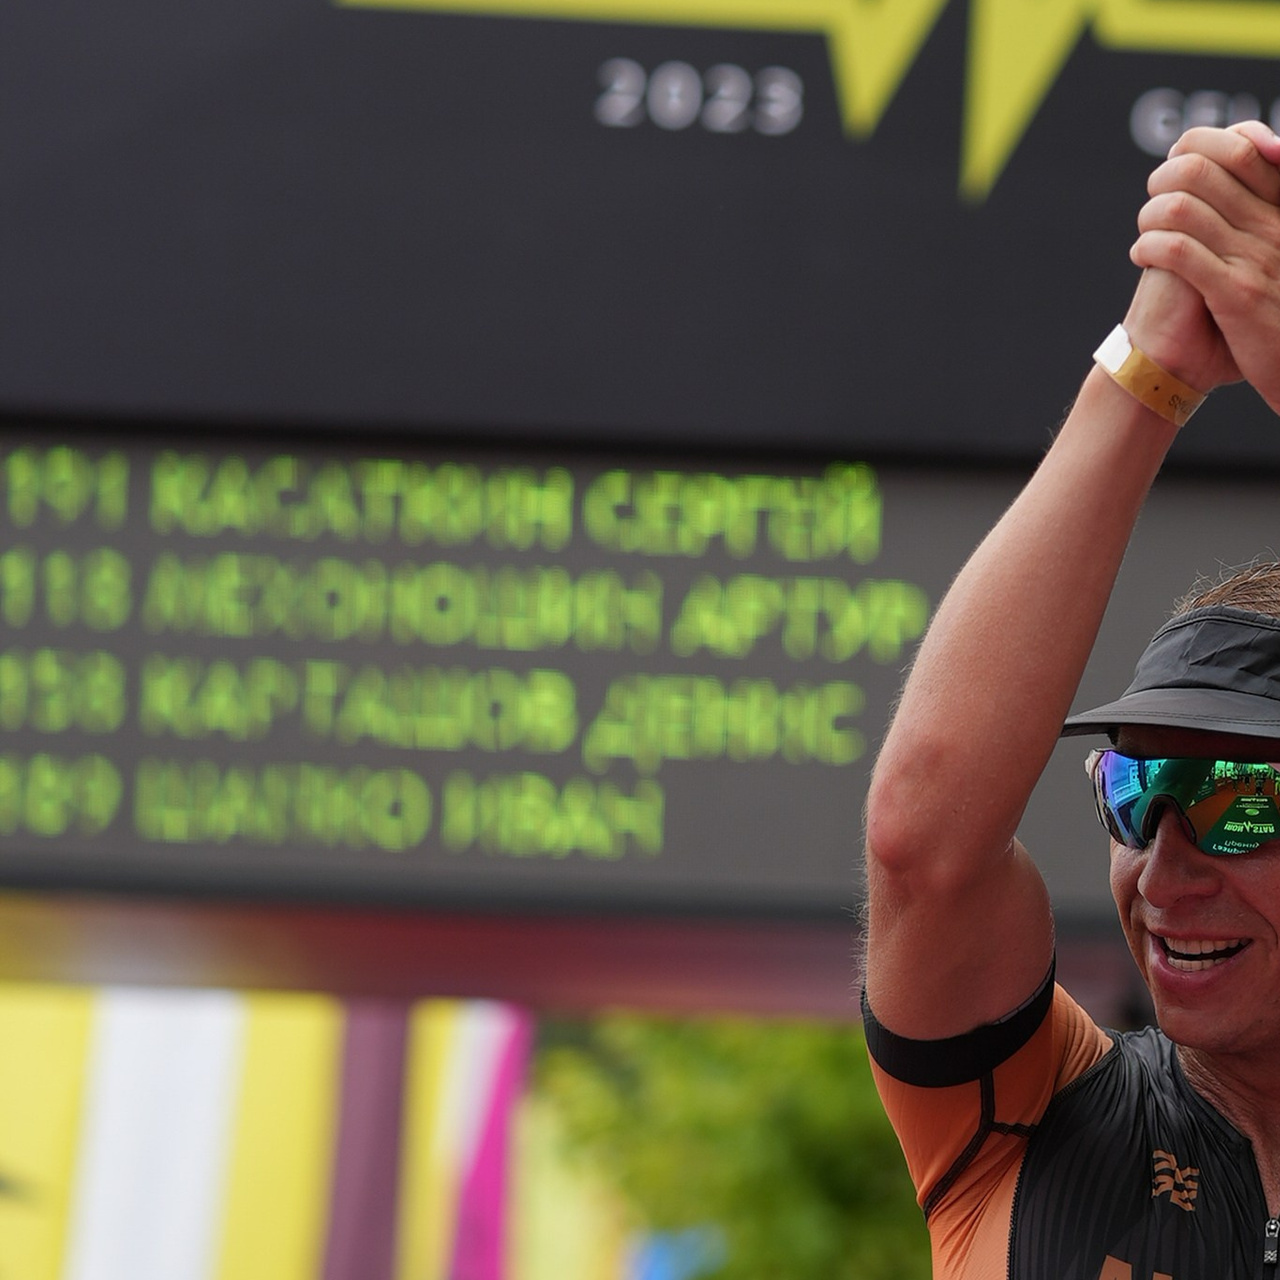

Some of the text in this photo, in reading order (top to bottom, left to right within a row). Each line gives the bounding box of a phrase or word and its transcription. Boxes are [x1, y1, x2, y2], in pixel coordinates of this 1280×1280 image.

[597, 59, 803, 136] 2023
[5, 446, 129, 530] 191
[150, 451, 574, 542] КАСАТКИН
[584, 462, 882, 563] СЕРГЕЙ
[672, 573, 930, 662] АРТУР
[582, 674, 864, 772] ДЕНИС
